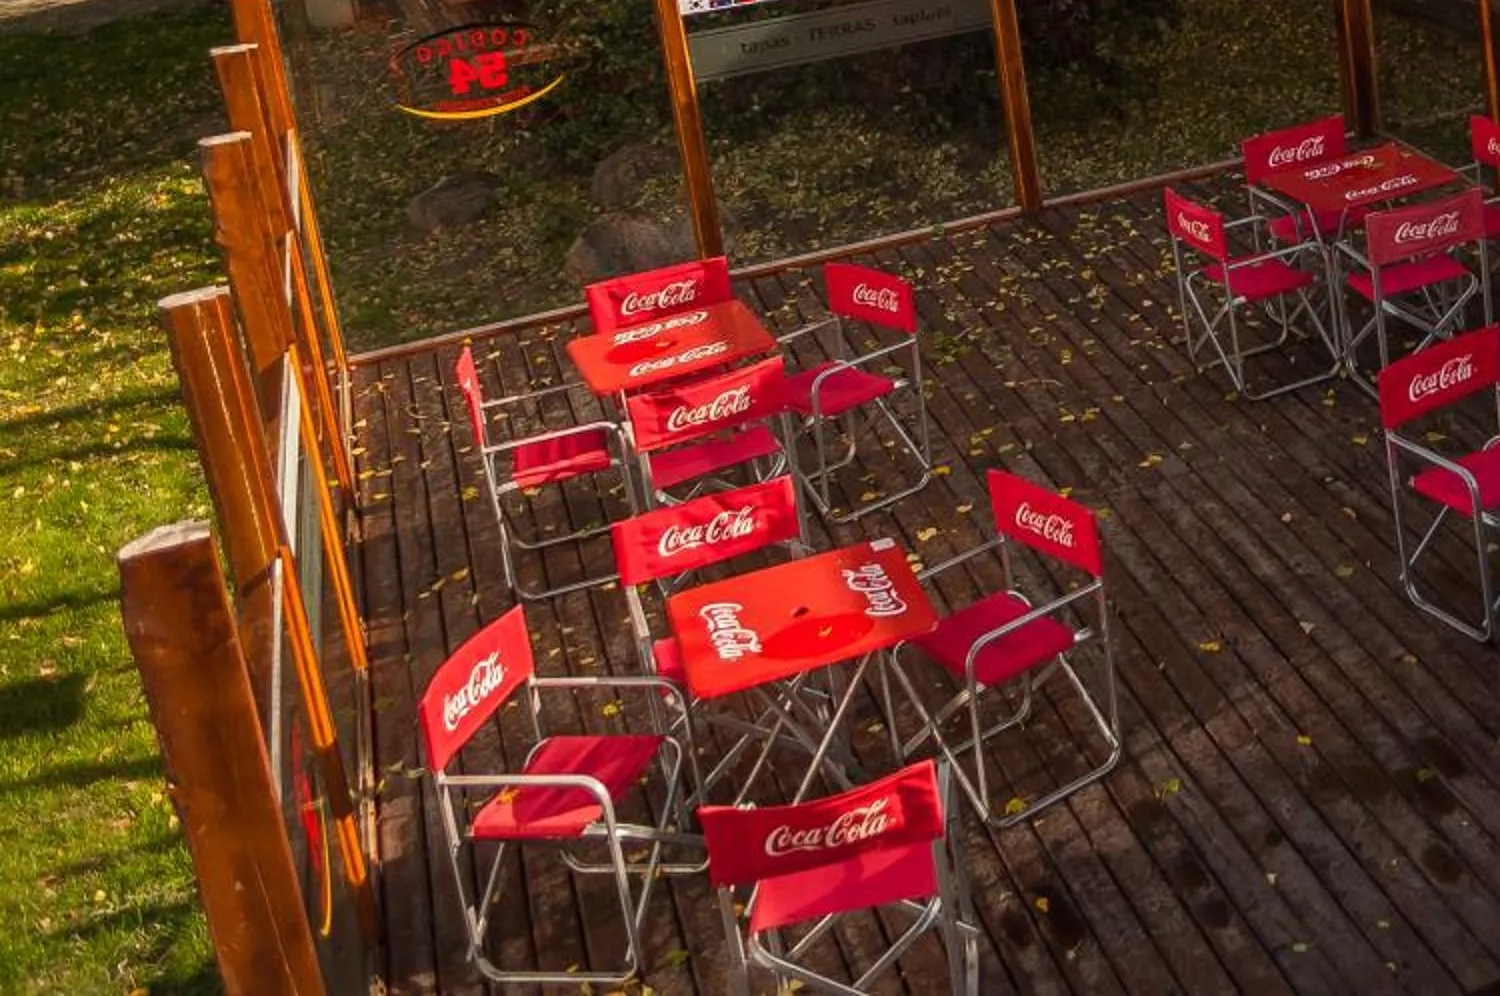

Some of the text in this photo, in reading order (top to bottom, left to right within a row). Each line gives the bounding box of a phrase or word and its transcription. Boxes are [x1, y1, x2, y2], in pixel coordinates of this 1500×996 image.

[1268, 135, 1325, 168] Coca-Cola
[1393, 211, 1461, 244] Coca-Cola
[620, 279, 696, 316] Coca-Cola
[853, 283, 898, 313] Coca-Cola
[1408, 355, 1472, 402] Coca-Cola
[666, 384, 751, 432] Coca-Cola
[657, 506, 761, 558] Coca-Cola
[1015, 502, 1073, 547] Coca-Cola
[841, 563, 908, 618] Coca-Cola
[699, 602, 762, 662] Coca-Cola
[442, 651, 505, 732] Coca-Cola
[764, 797, 889, 856] Coca-Cola
